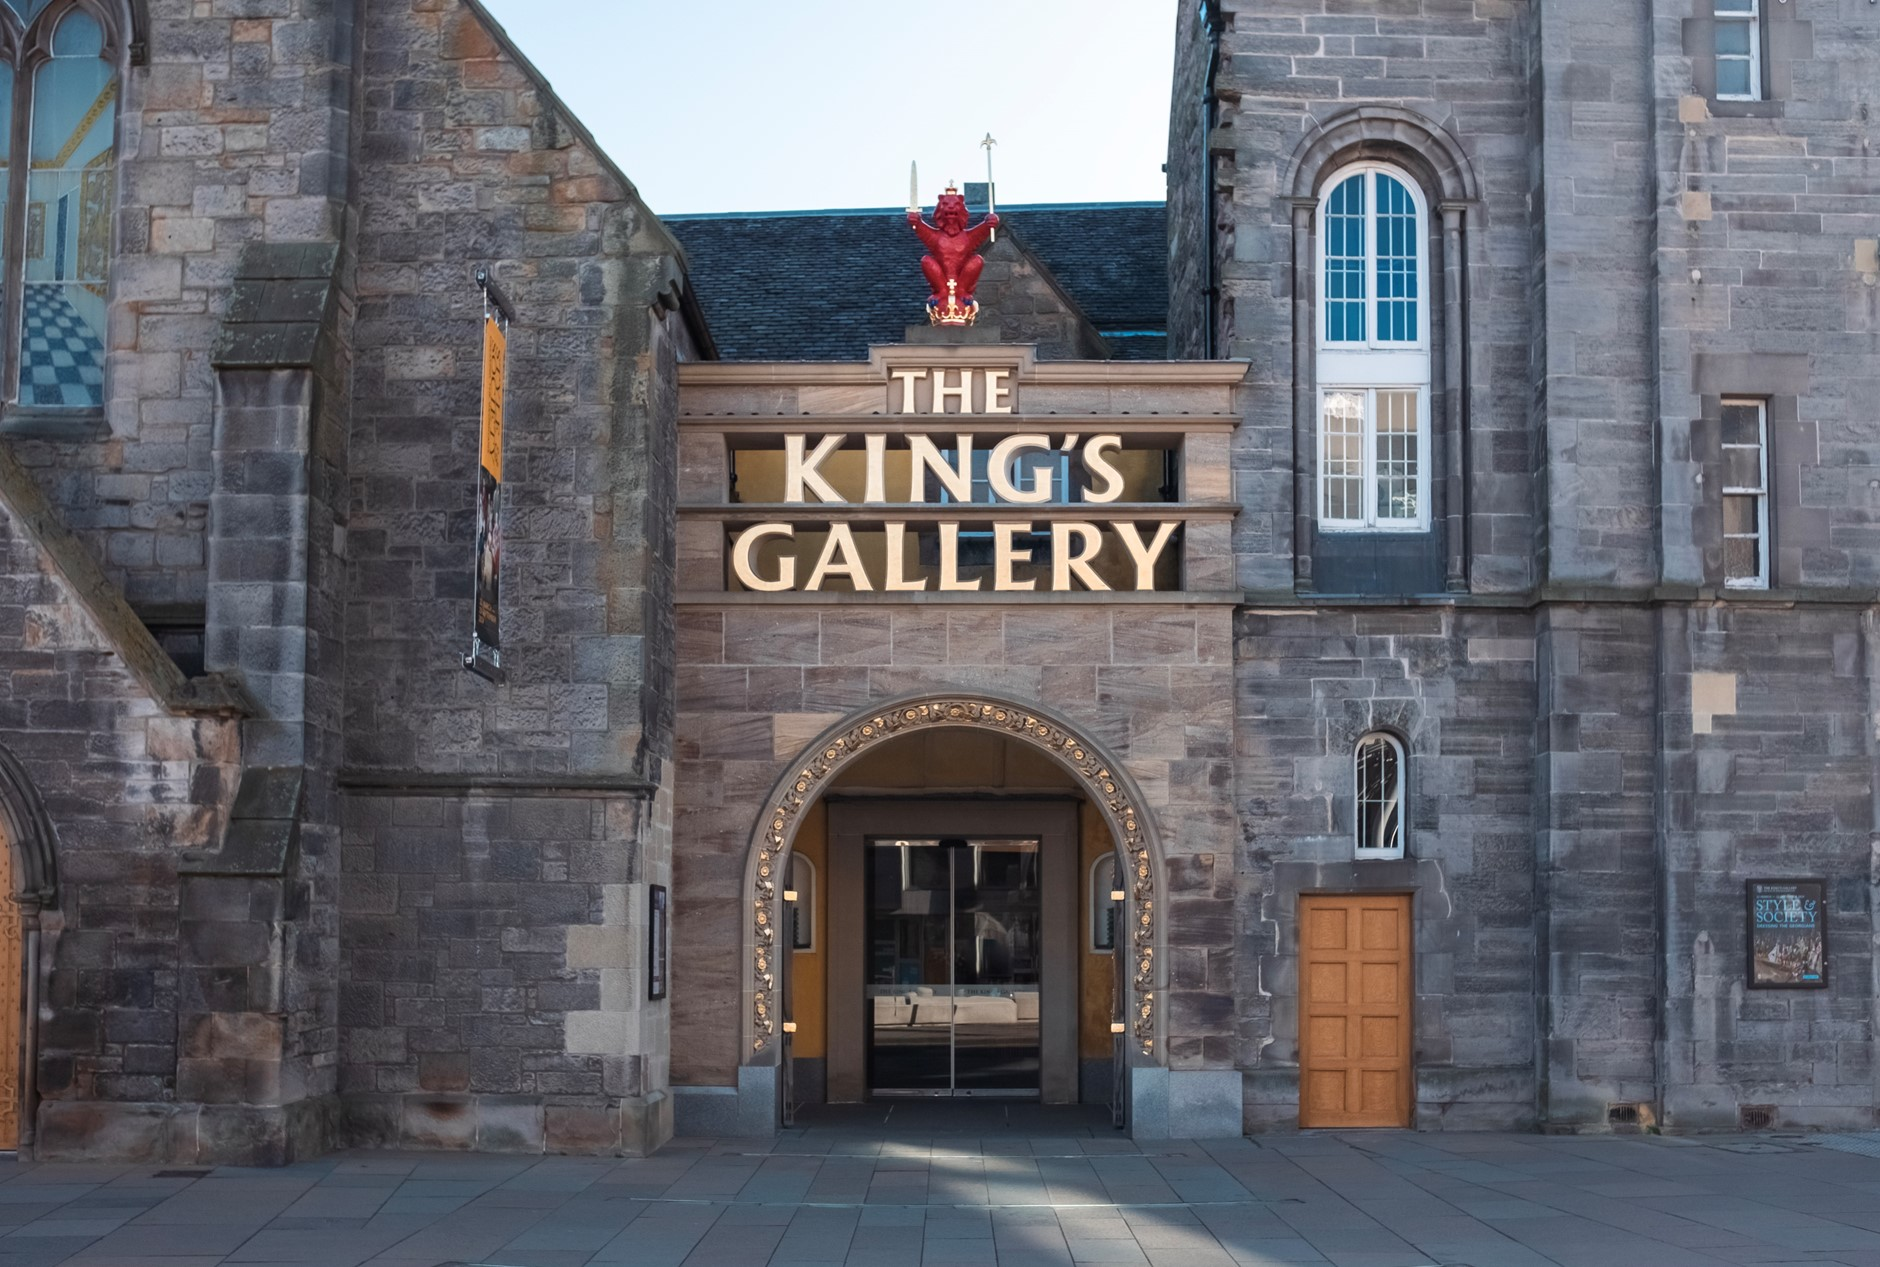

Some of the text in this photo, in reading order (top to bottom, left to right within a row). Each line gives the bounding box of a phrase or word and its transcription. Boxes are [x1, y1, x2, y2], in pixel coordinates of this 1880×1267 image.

[891, 369, 1012, 414] THE
[784, 433, 1124, 503] KING'S
[732, 521, 1179, 591] GALLERY
[1756, 899, 1816, 911] STYLE &
[1756, 911, 1818, 923] SOCIETY
